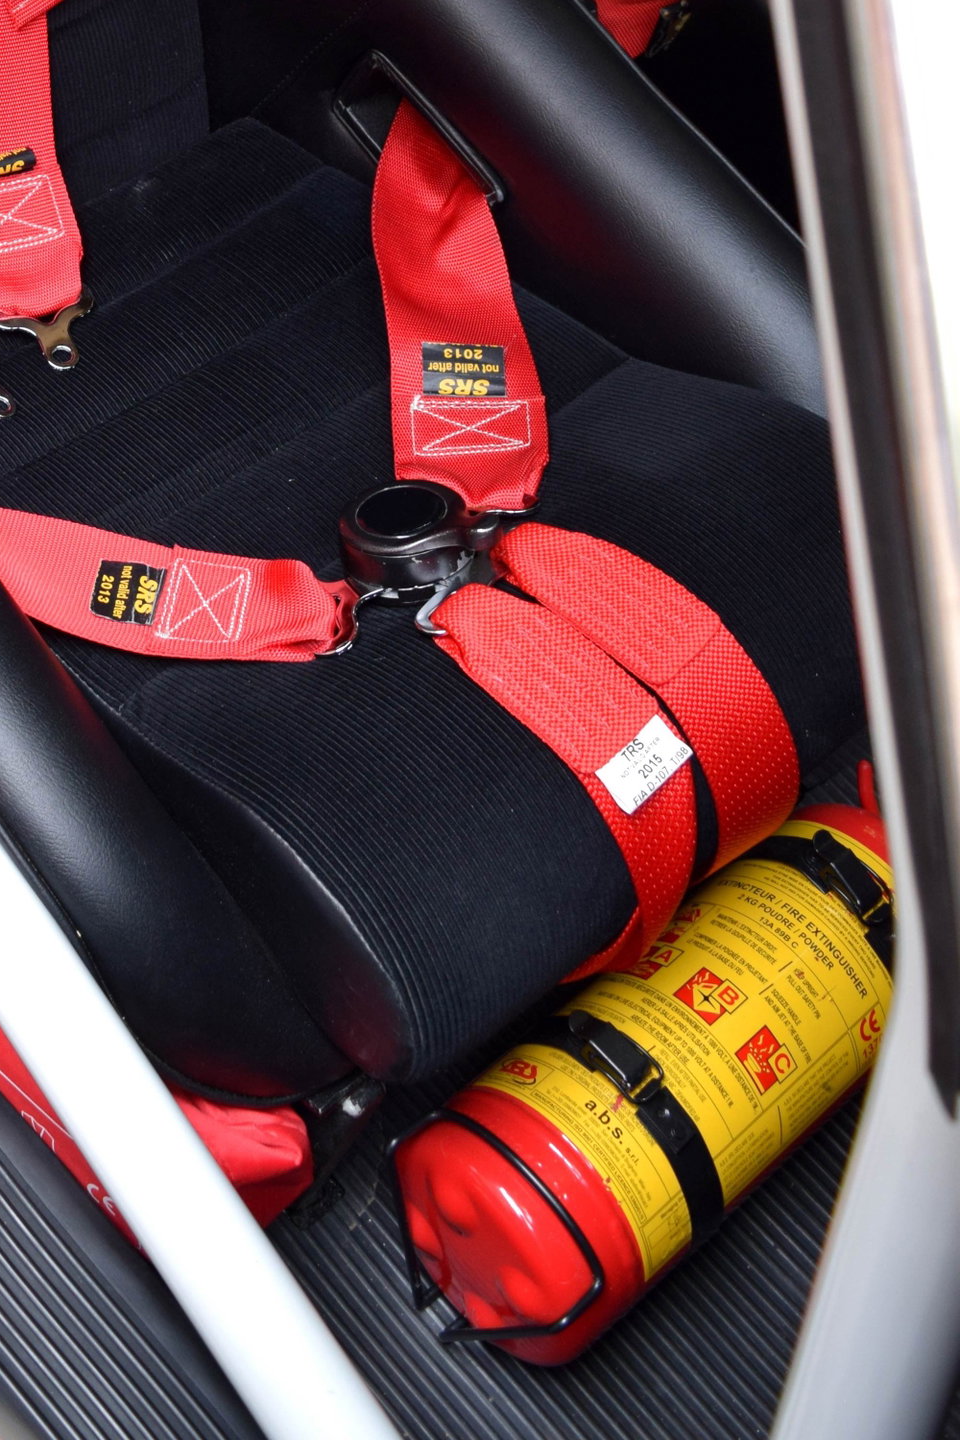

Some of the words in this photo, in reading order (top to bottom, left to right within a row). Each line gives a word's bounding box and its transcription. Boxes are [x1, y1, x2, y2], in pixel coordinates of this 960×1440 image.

[443, 348, 483, 359] 2013
[427, 362, 453, 372] after
[455, 363, 480, 373] valid
[482, 364, 499, 373] not
[438, 378, 490, 396] SRS
[121, 565, 133, 579] not
[97, 574, 115, 604] 2013
[117, 579, 132, 601] valid
[133, 575, 158, 615] SRS
[113, 600, 128, 619] after
[620, 738, 645, 762] TRS
[638, 753, 663, 779] 2015
[632, 790, 648, 806] FIA
[717, 879, 777, 903] EXTINCTEUR
[780, 902, 808, 923] FIRE
[806, 921, 868, 999] EXTINGUISHER
[744, 895, 758, 906] KG
[758, 901, 795, 934] POUDRE
[798, 931, 834, 971] POWDER
[758, 916, 774, 932] 13A
[774, 927, 791, 942] 89B
[791, 940, 800, 949] C
[749, 941, 758, 949] DE
[655, 950, 673, 962] A
[716, 953, 730, 964] BASE
[727, 961, 736, 969] DU
[733, 965, 744, 976] FEU
[737, 957, 746, 965] EN
[785, 974, 797, 988] PULL
[717, 985, 739, 1006] B
[645, 1023, 657, 1033] THE
[665, 1040, 682, 1056] AFTER
[673, 1033, 682, 1042] UP
[679, 1039, 688, 1048] TO
[693, 1054, 707, 1069] VOLT
[774, 1053, 791, 1074] C
[584, 1099, 623, 1144] a.b.s.
